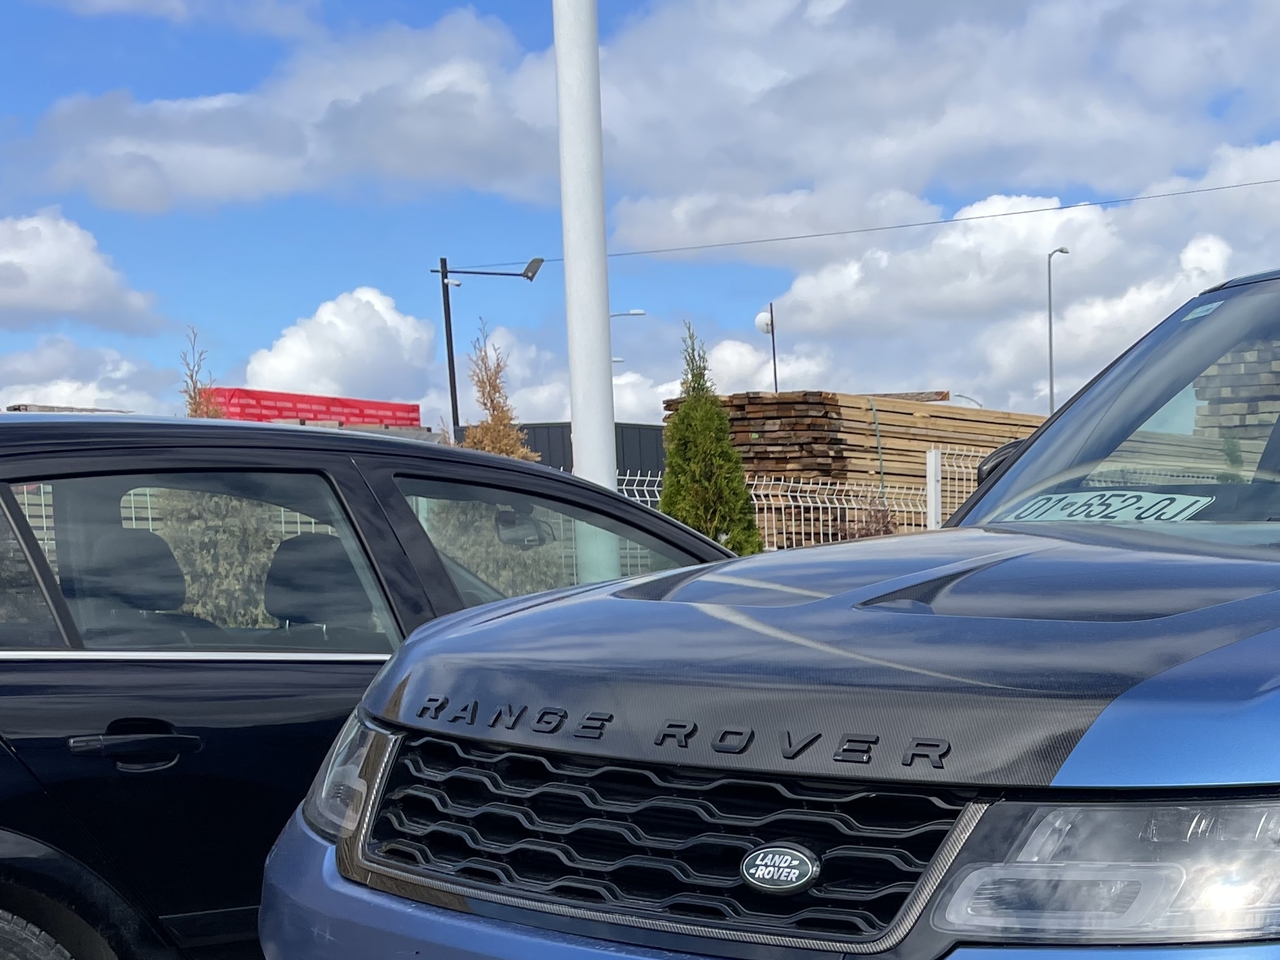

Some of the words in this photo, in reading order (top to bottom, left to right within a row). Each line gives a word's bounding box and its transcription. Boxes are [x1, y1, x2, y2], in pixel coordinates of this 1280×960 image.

[416, 693, 614, 740] RANGE
[653, 718, 952, 769] ROVER
[755, 853, 792, 868] LAND
[754, 866, 799, 882] ROVER
